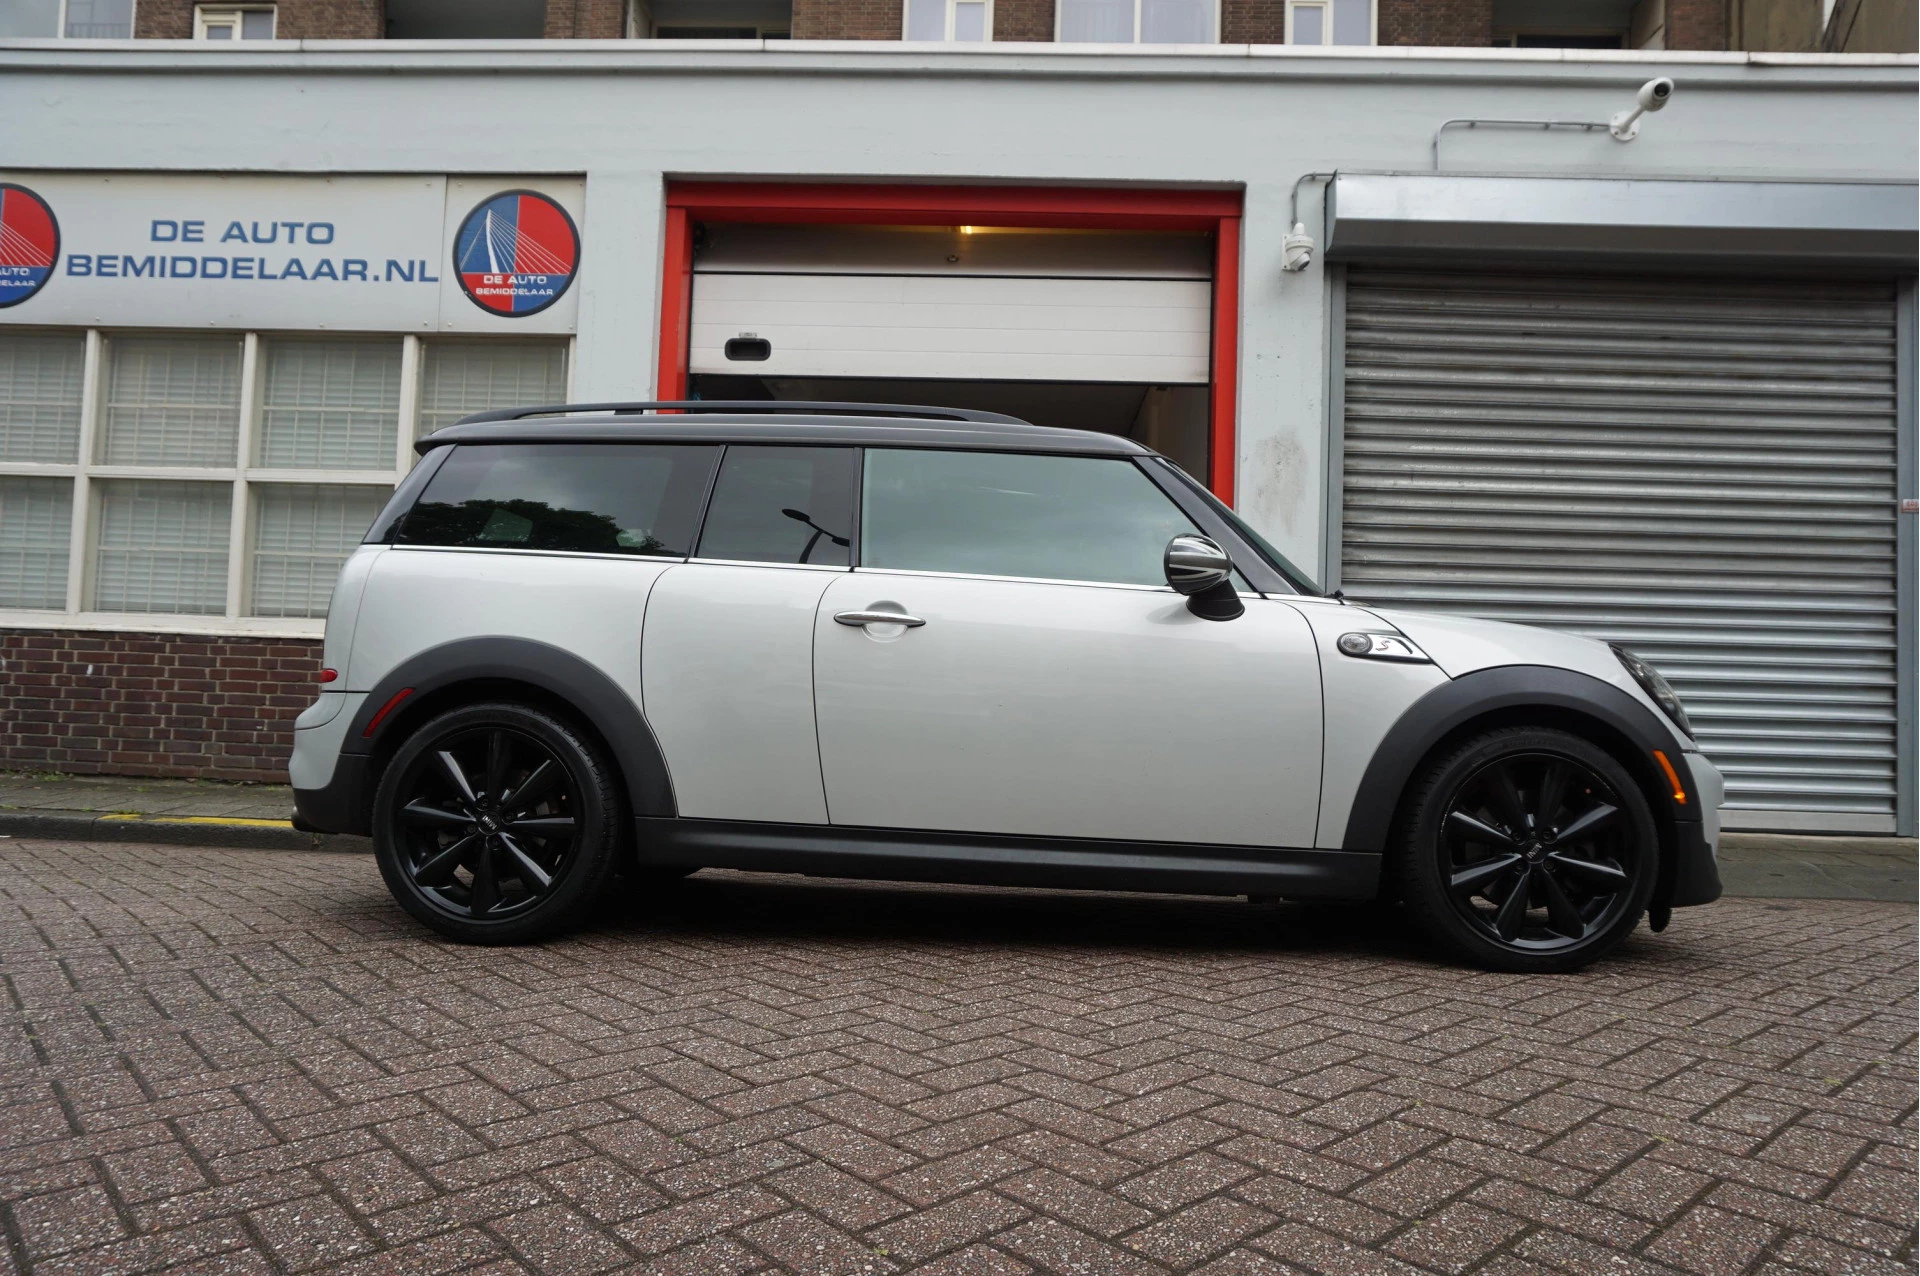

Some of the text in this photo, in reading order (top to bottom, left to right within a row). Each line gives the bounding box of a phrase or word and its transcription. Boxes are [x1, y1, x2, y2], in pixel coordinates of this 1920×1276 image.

[150, 219, 335, 245] DE AUTO
[0, 266, 30, 276] UTO
[66, 253, 440, 283] BEMIDDELAAR.NL
[482, 274, 548, 285] DE AUTO
[475, 286, 554, 296] BEMIDDELAAR
